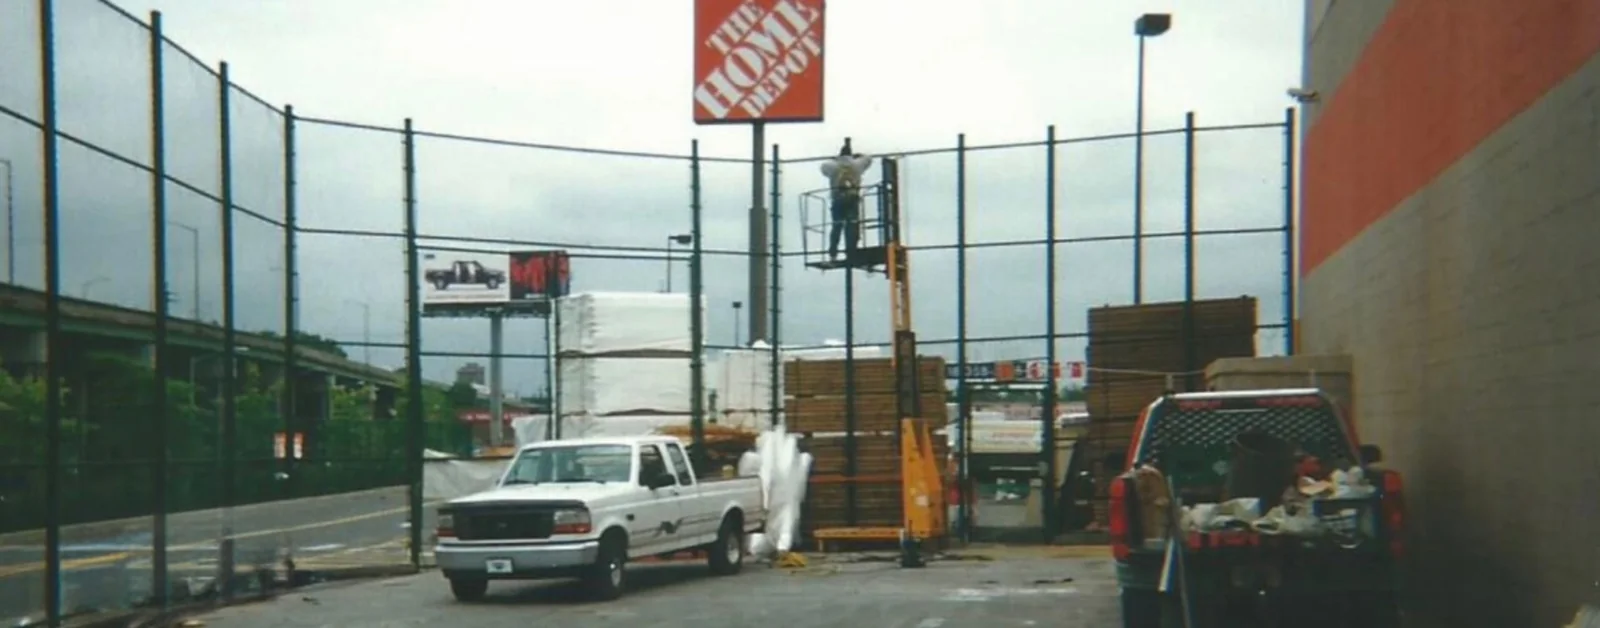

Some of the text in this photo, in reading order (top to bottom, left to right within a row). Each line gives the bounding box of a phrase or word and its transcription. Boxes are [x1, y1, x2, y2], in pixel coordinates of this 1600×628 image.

[695, 0, 820, 118] HOME
[705, 0, 765, 55] THE
[740, 30, 821, 118] DEPOT
